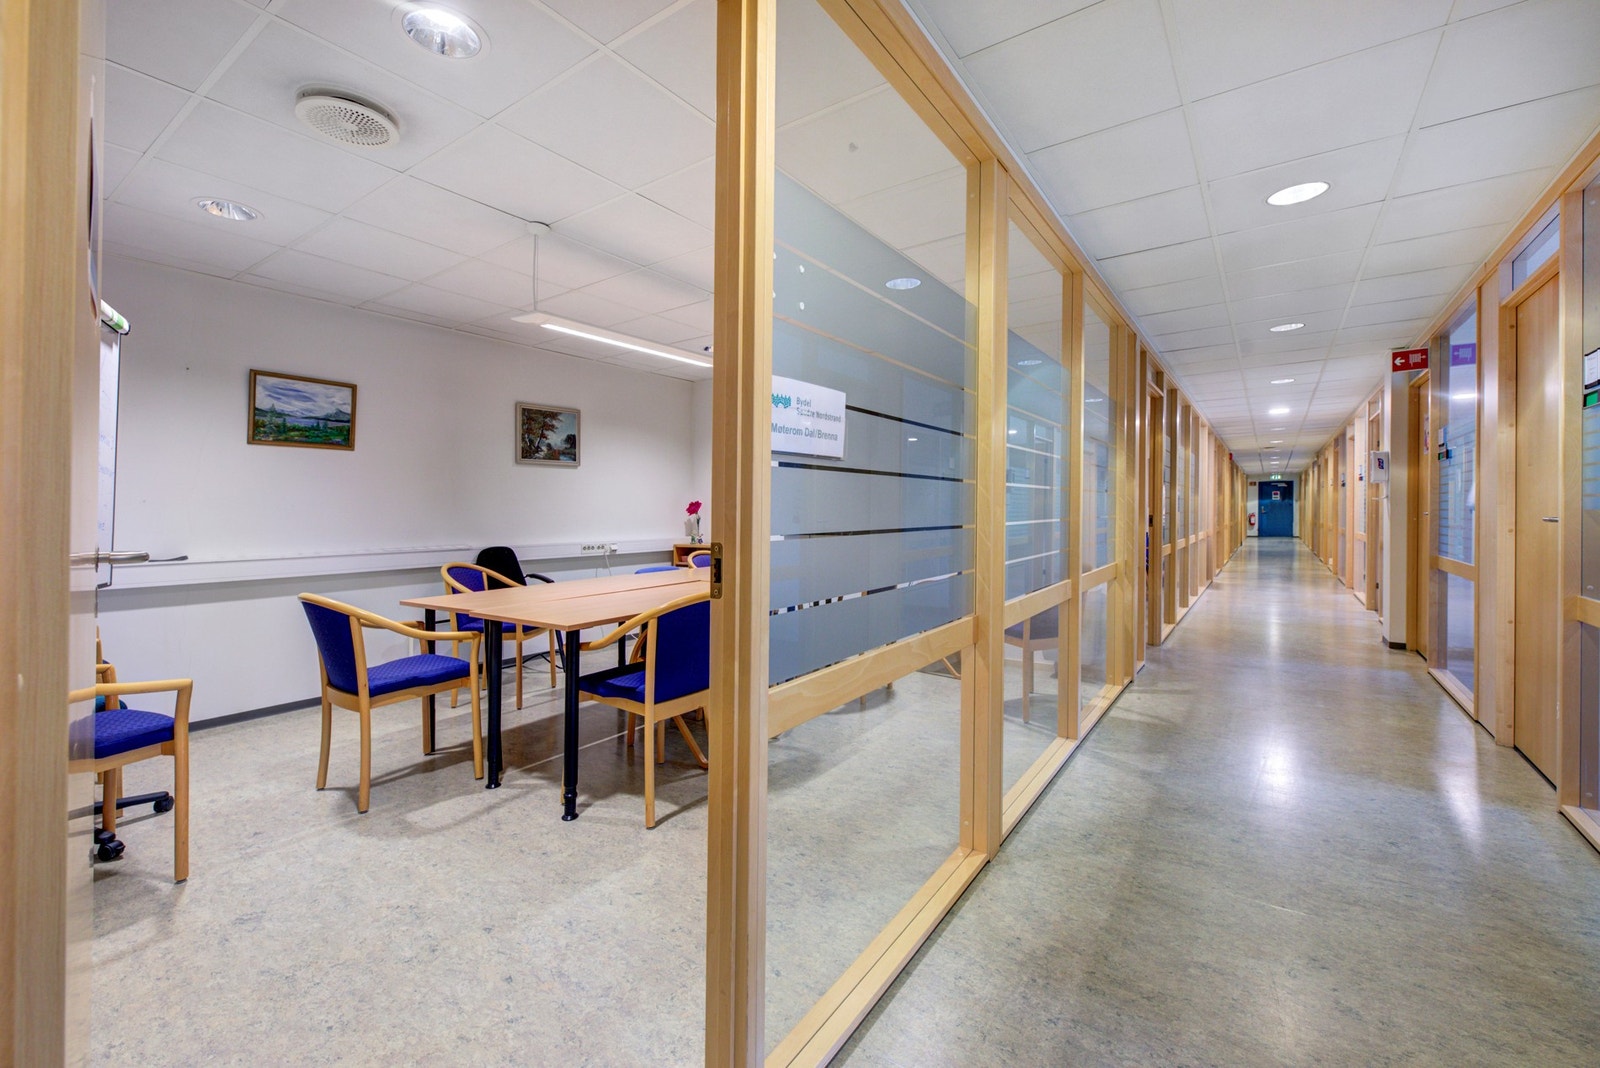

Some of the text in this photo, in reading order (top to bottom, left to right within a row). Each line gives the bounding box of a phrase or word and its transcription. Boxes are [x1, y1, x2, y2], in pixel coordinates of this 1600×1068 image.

[796, 396, 812, 407] Bydel
[815, 411, 841, 422] Nordstrand
[771, 423, 838, 441] Møterom Dal/Brenna
